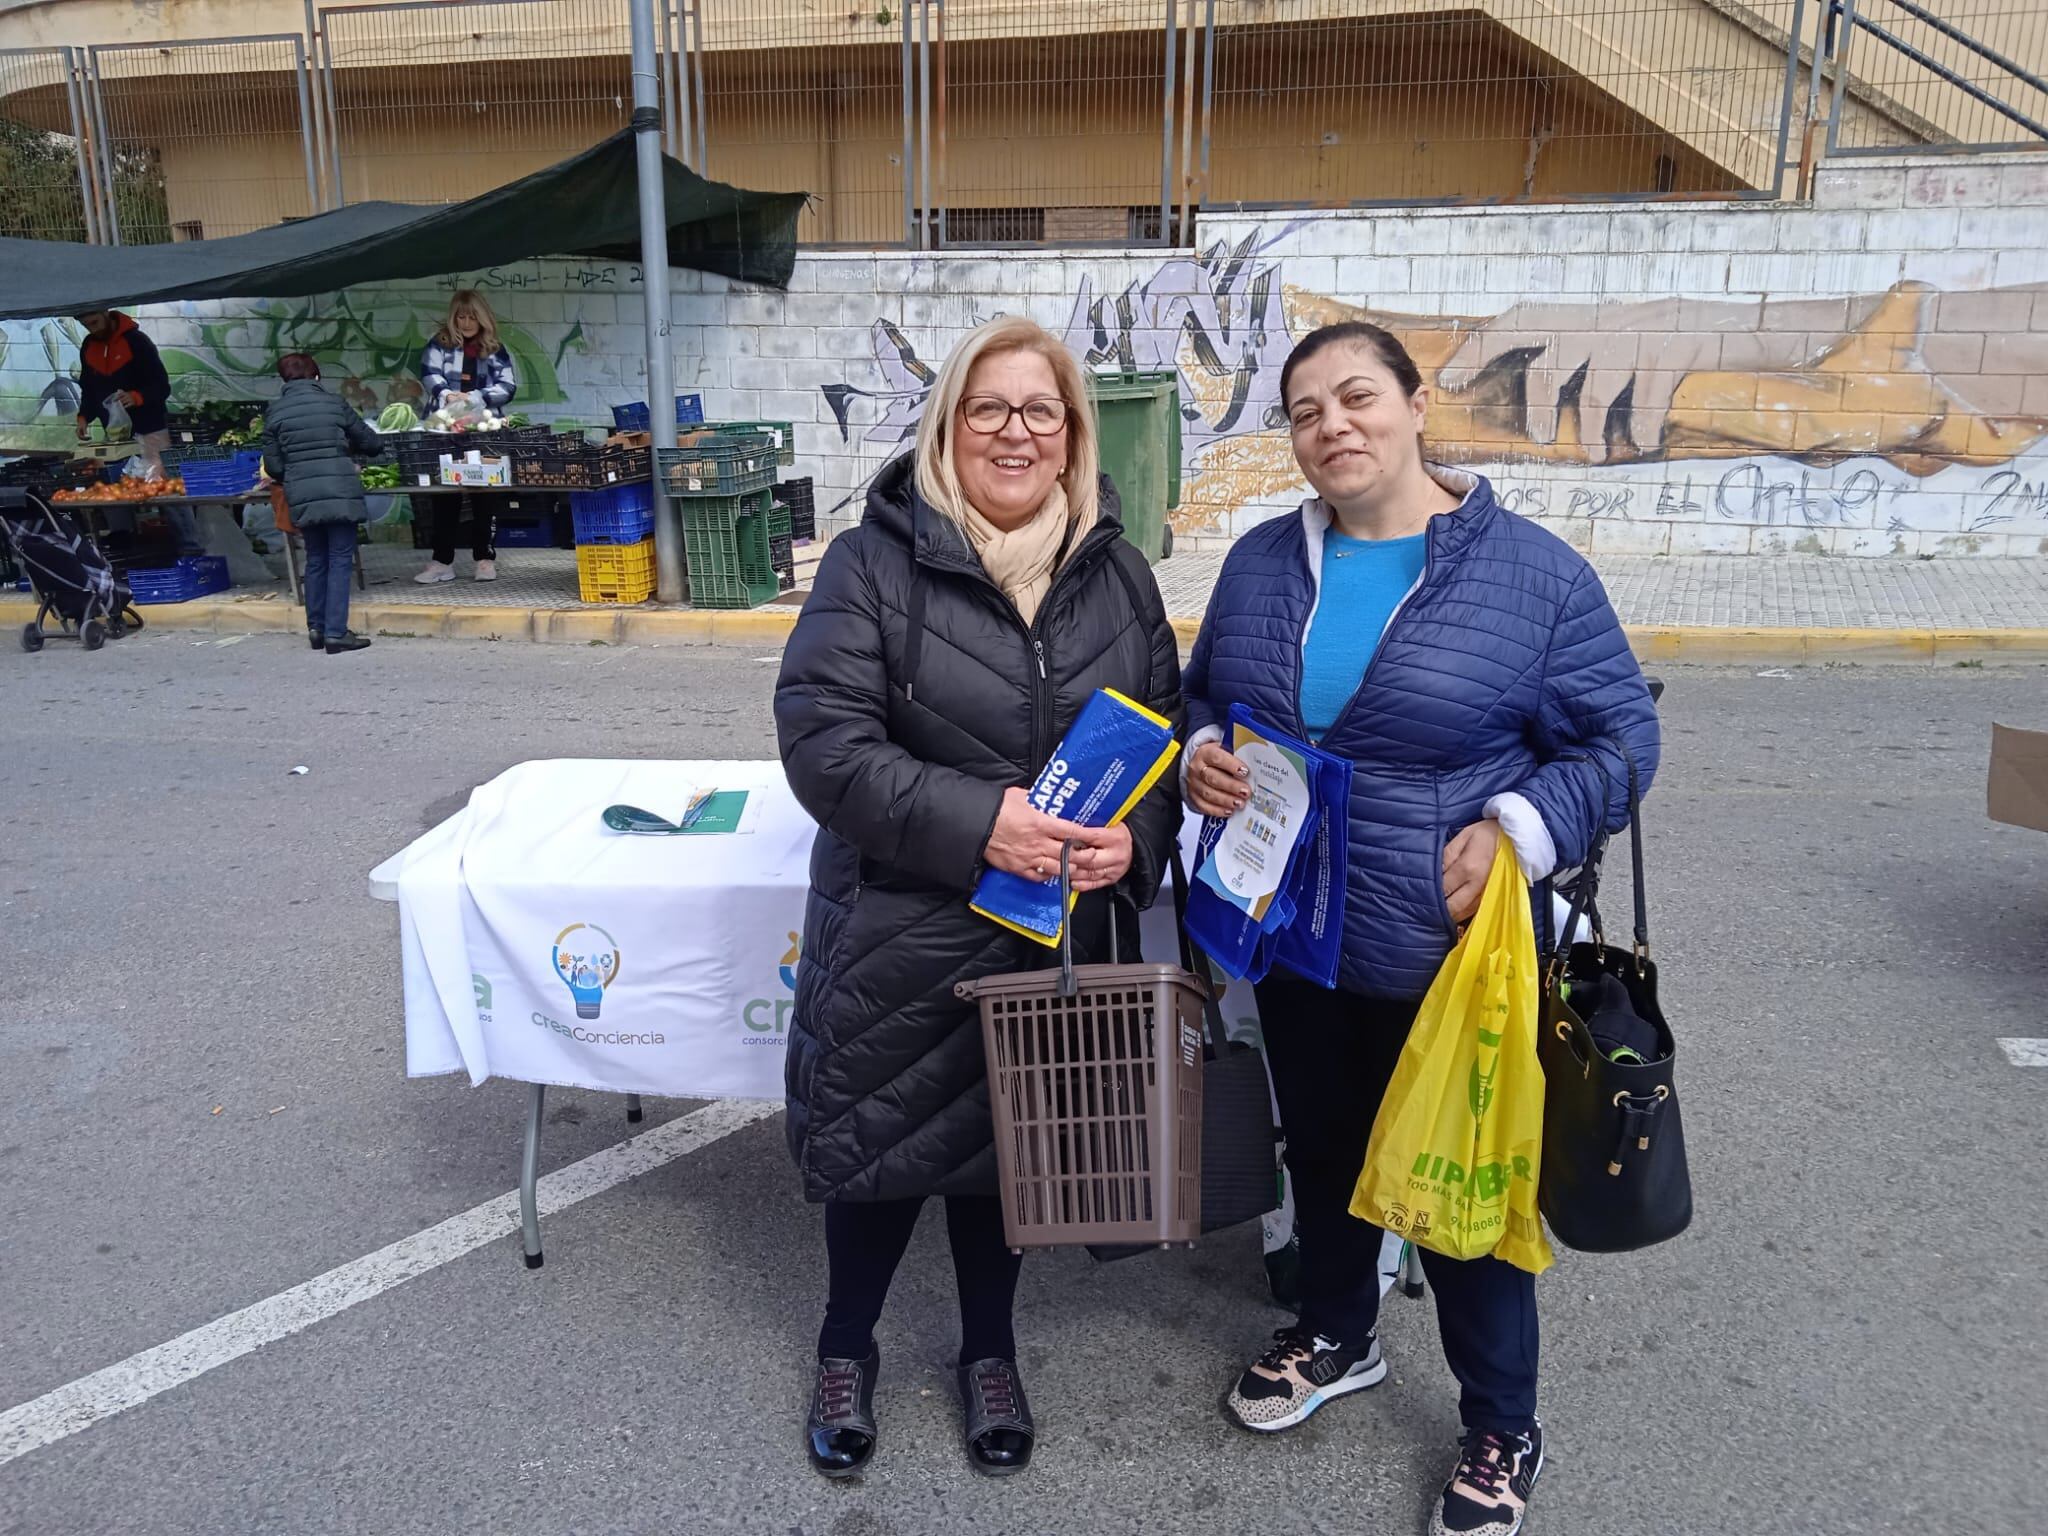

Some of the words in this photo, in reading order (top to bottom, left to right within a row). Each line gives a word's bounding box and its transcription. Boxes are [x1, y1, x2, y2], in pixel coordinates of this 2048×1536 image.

[1568, 486, 1635, 519] POR
[1656, 474, 1703, 515] EL
[1047, 777, 1081, 818] APER
[531, 1012, 665, 1045] creaConciencia
